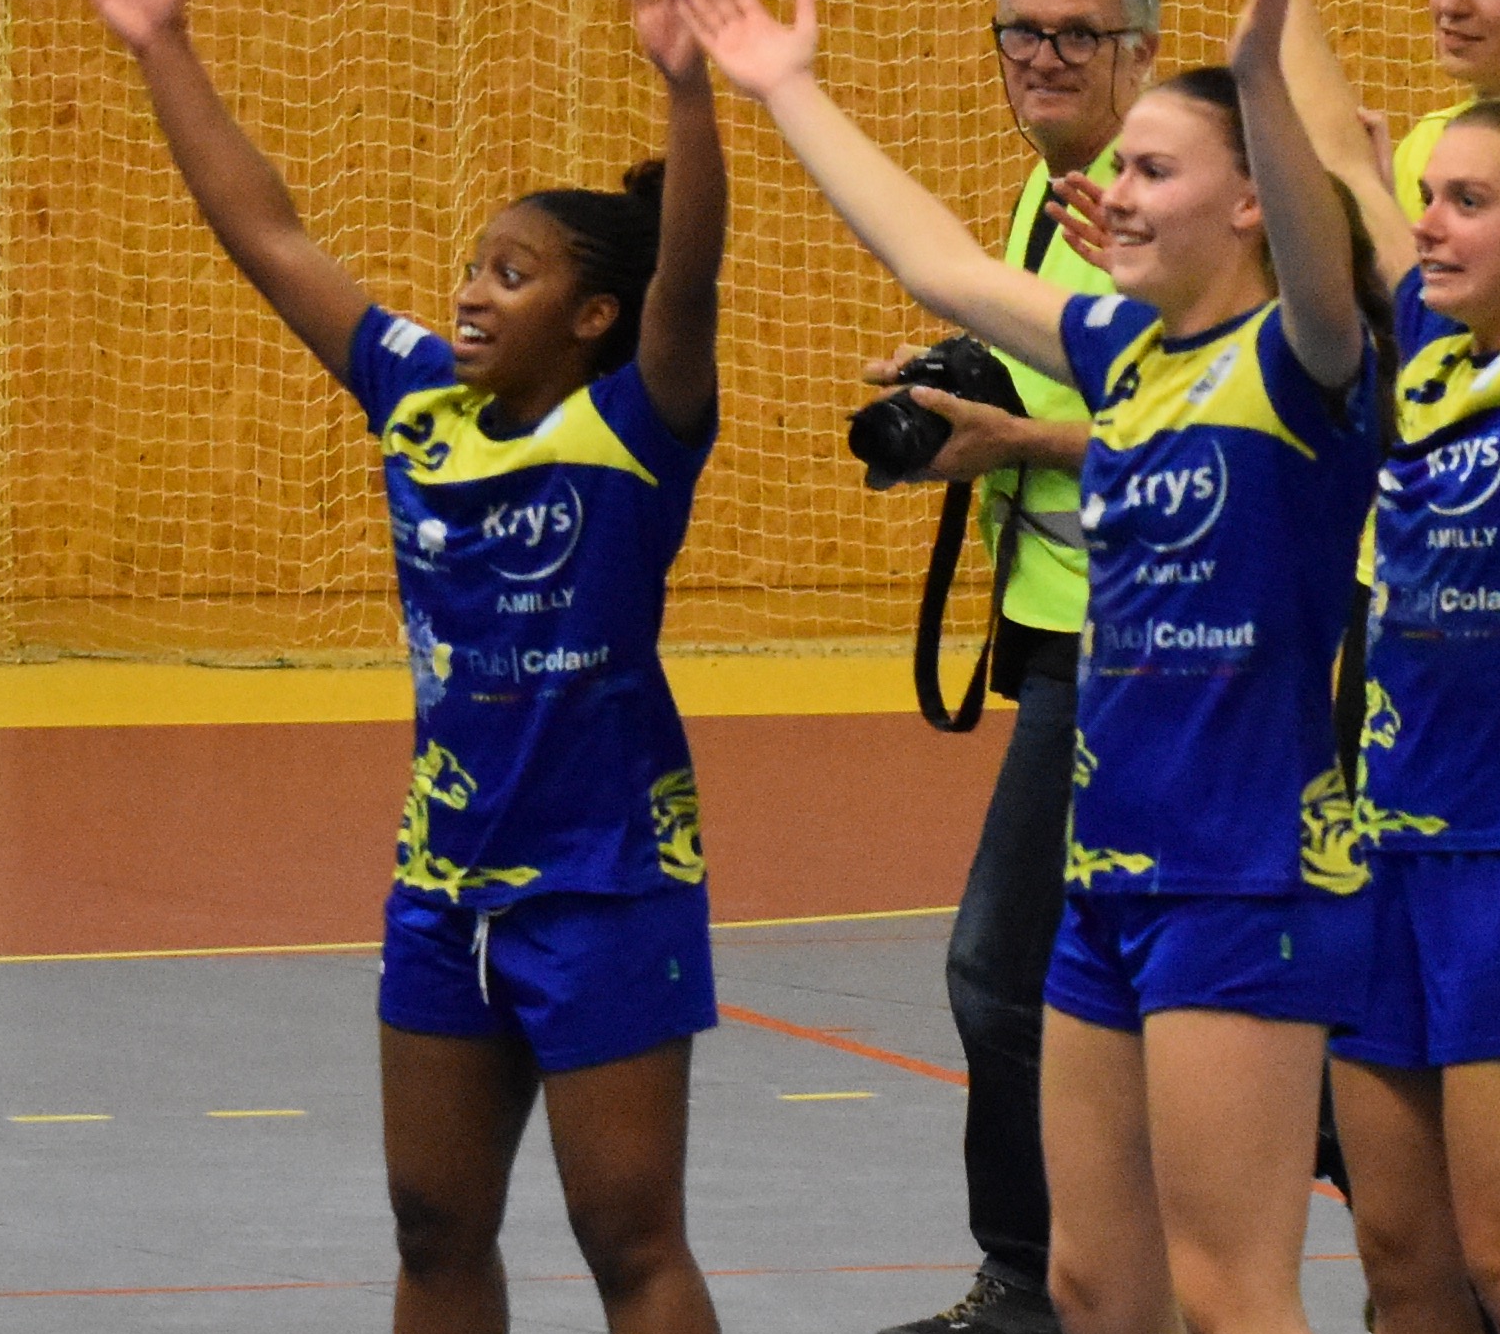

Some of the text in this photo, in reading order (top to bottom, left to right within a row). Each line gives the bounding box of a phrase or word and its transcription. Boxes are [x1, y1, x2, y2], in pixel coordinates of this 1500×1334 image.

[483, 501, 573, 549] Krys
[496, 586, 575, 614] AMILLY
[1153, 619, 1255, 649] Colaut
[521, 645, 610, 675] Colaut
